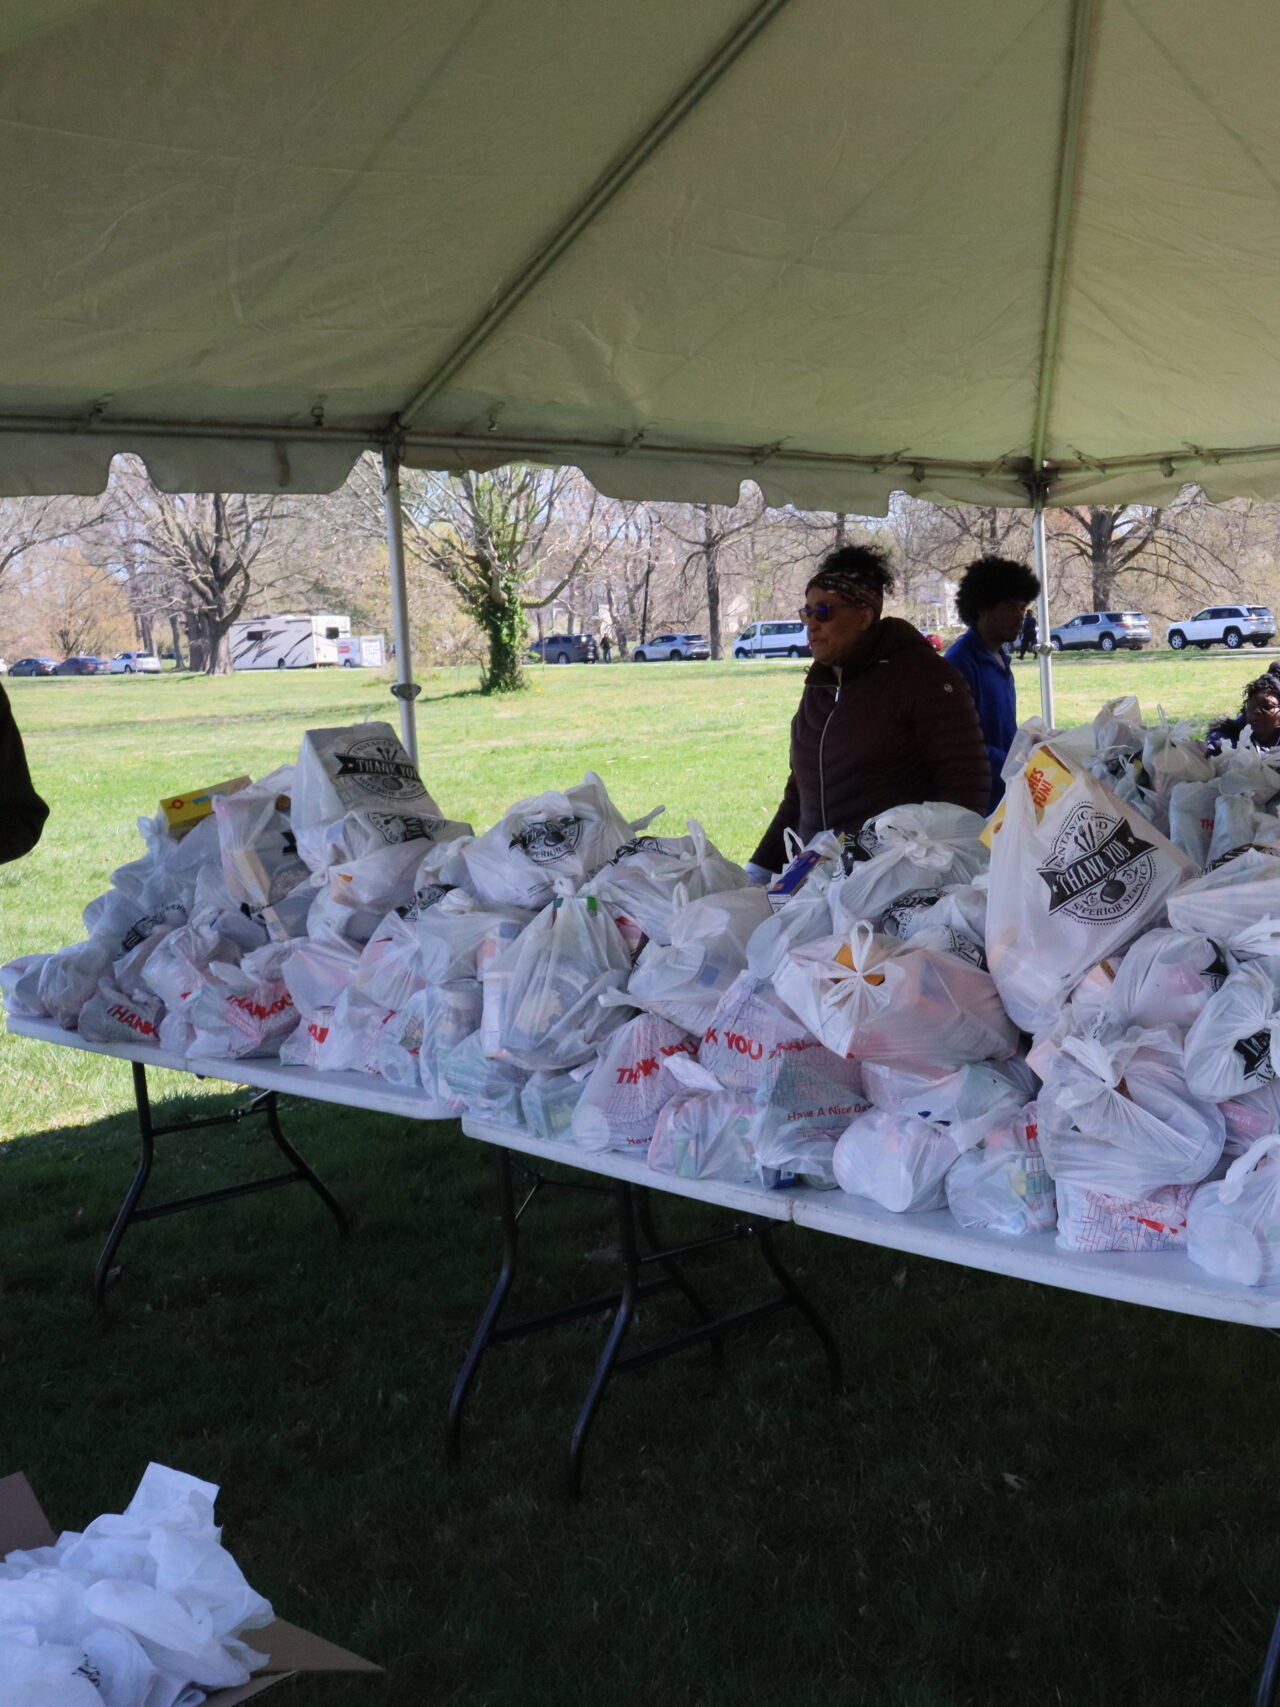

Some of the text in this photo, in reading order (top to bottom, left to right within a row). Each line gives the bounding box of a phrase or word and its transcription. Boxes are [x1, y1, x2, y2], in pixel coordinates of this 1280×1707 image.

[1033, 785, 1054, 808] FUN!
[1057, 839, 1132, 895] THANK YOU
[1124, 860, 1149, 905] SERVICE
[723, 1031, 763, 1060] YOU
[616, 1056, 660, 1085] THNK
[818, 1107, 826, 1117] A
[829, 1104, 853, 1116] Nice
